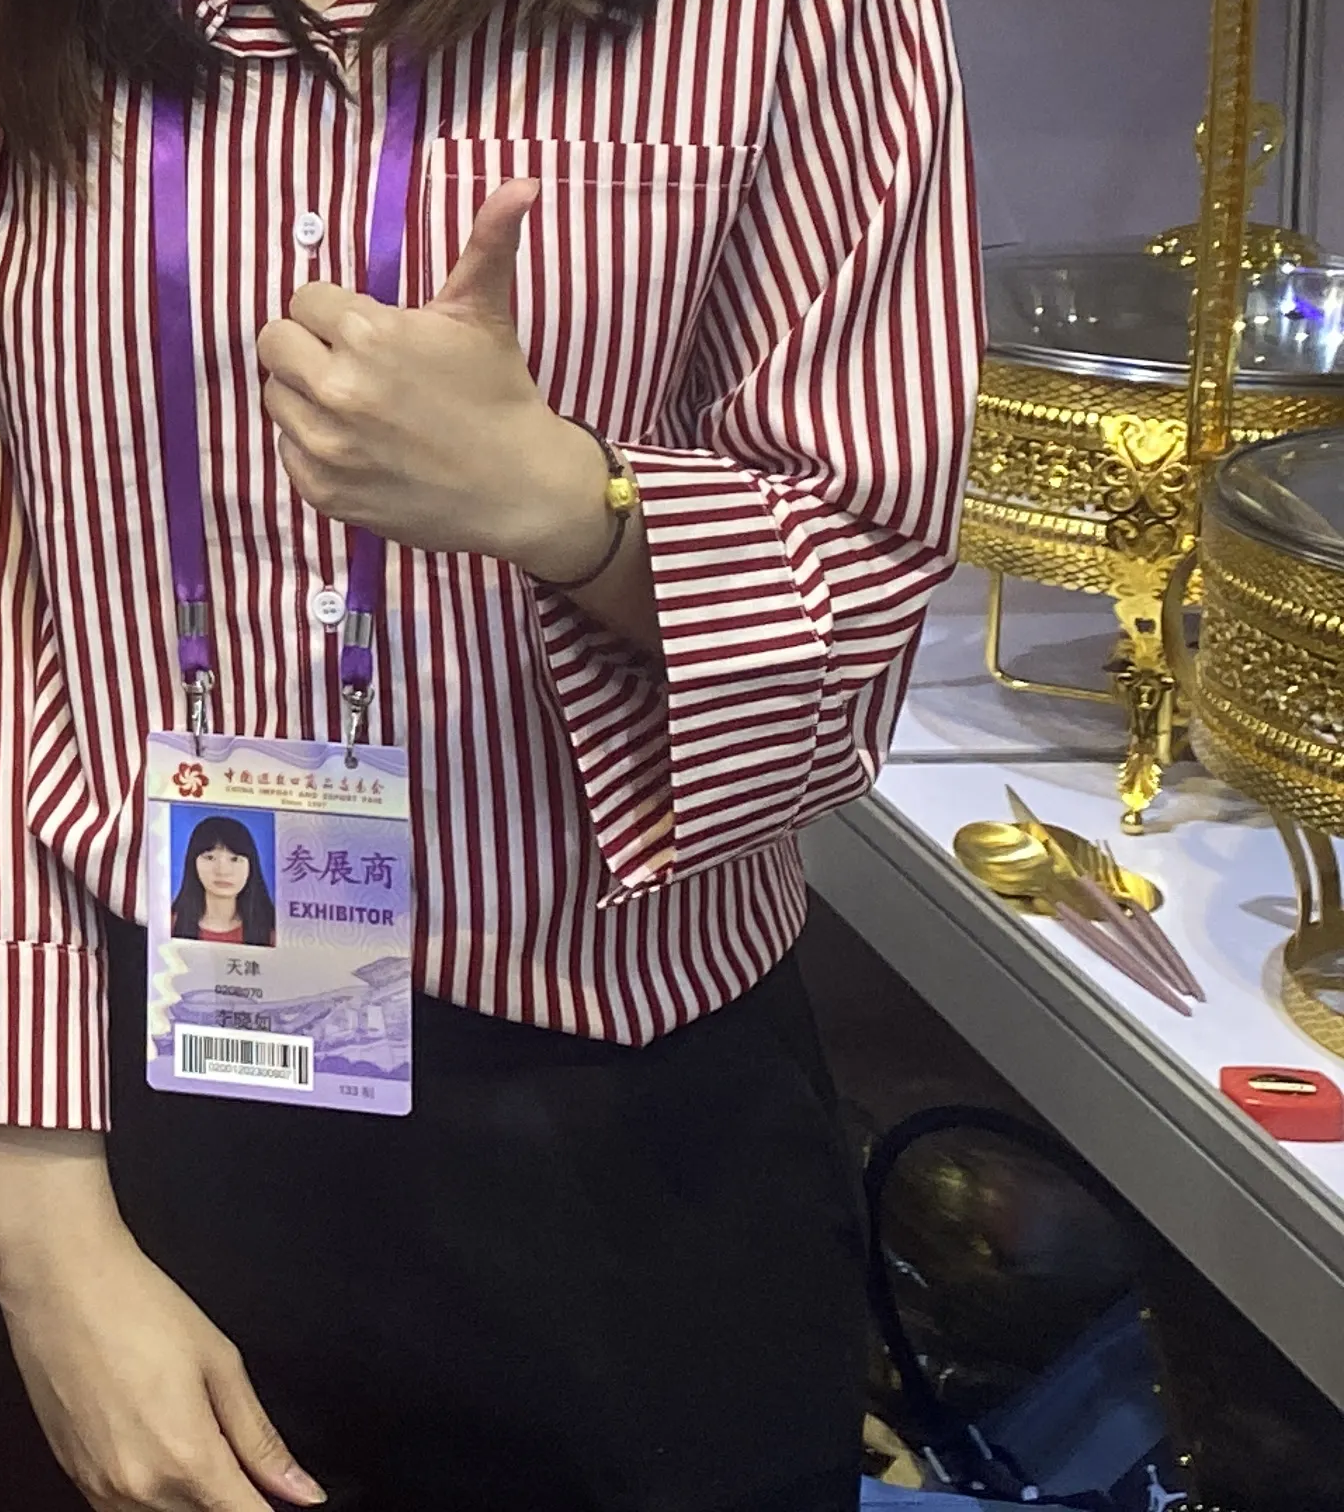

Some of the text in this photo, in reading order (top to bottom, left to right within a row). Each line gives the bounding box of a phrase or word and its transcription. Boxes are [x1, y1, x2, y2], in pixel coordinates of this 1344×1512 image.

[281, 845, 396, 890] 参展商
[288, 900, 395, 927] EXHIBITOR
[226, 956, 261, 978] 天津
